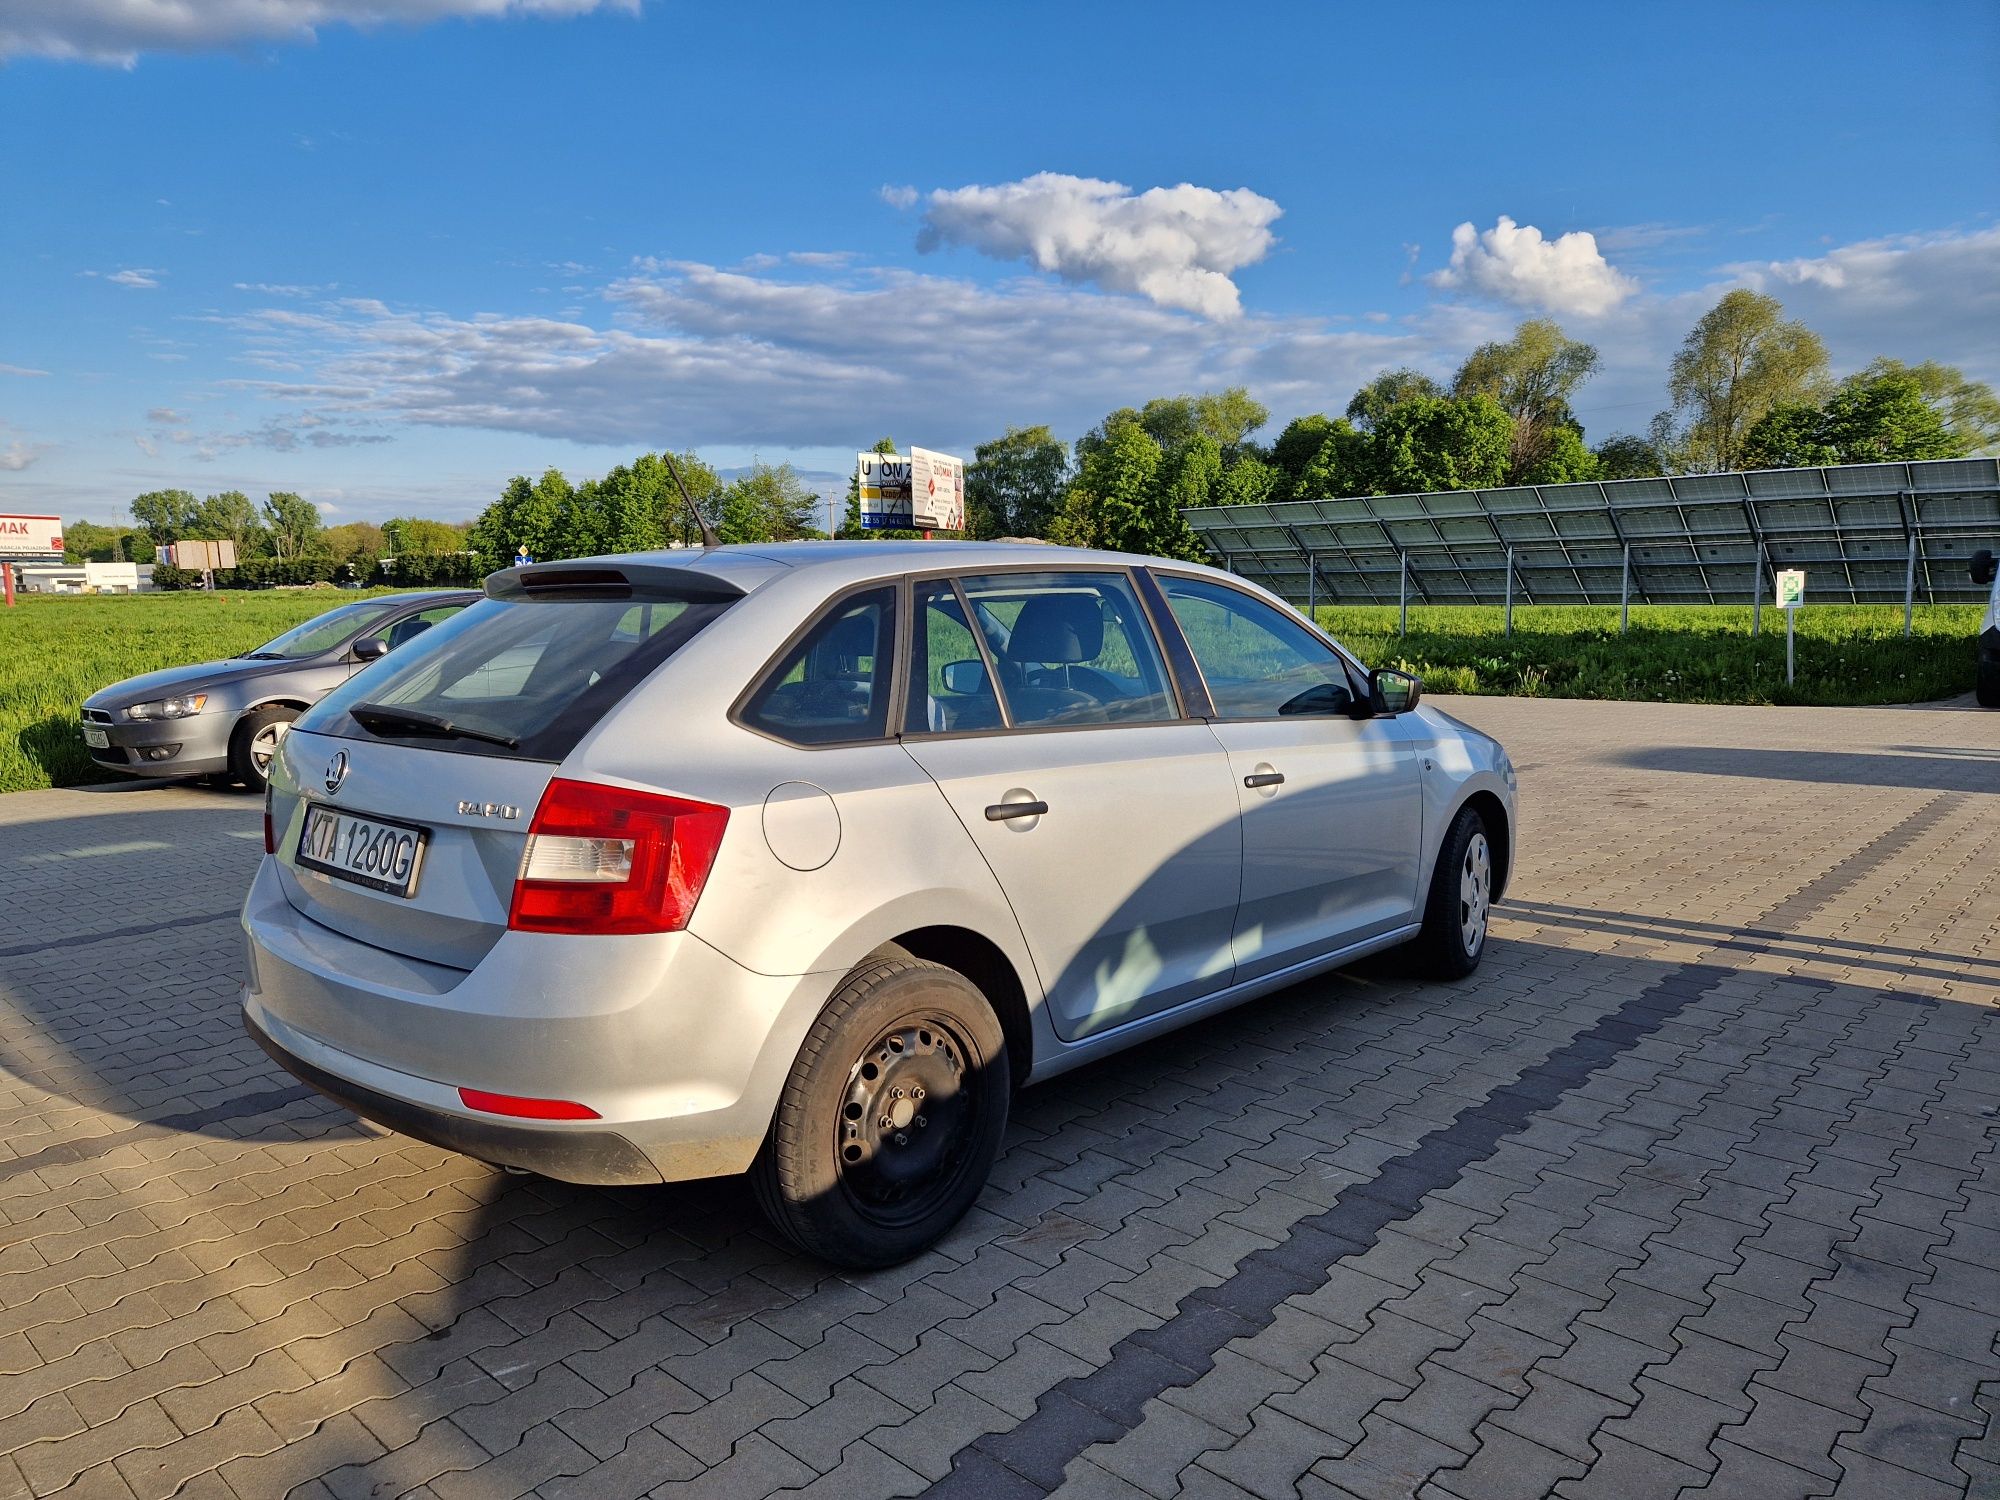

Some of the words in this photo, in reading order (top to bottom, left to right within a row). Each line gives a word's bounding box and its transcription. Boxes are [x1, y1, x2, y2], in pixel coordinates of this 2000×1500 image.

[457, 800, 521, 820] RAPID
[306, 812, 340, 862] KTA
[344, 820, 414, 880] 1260G
